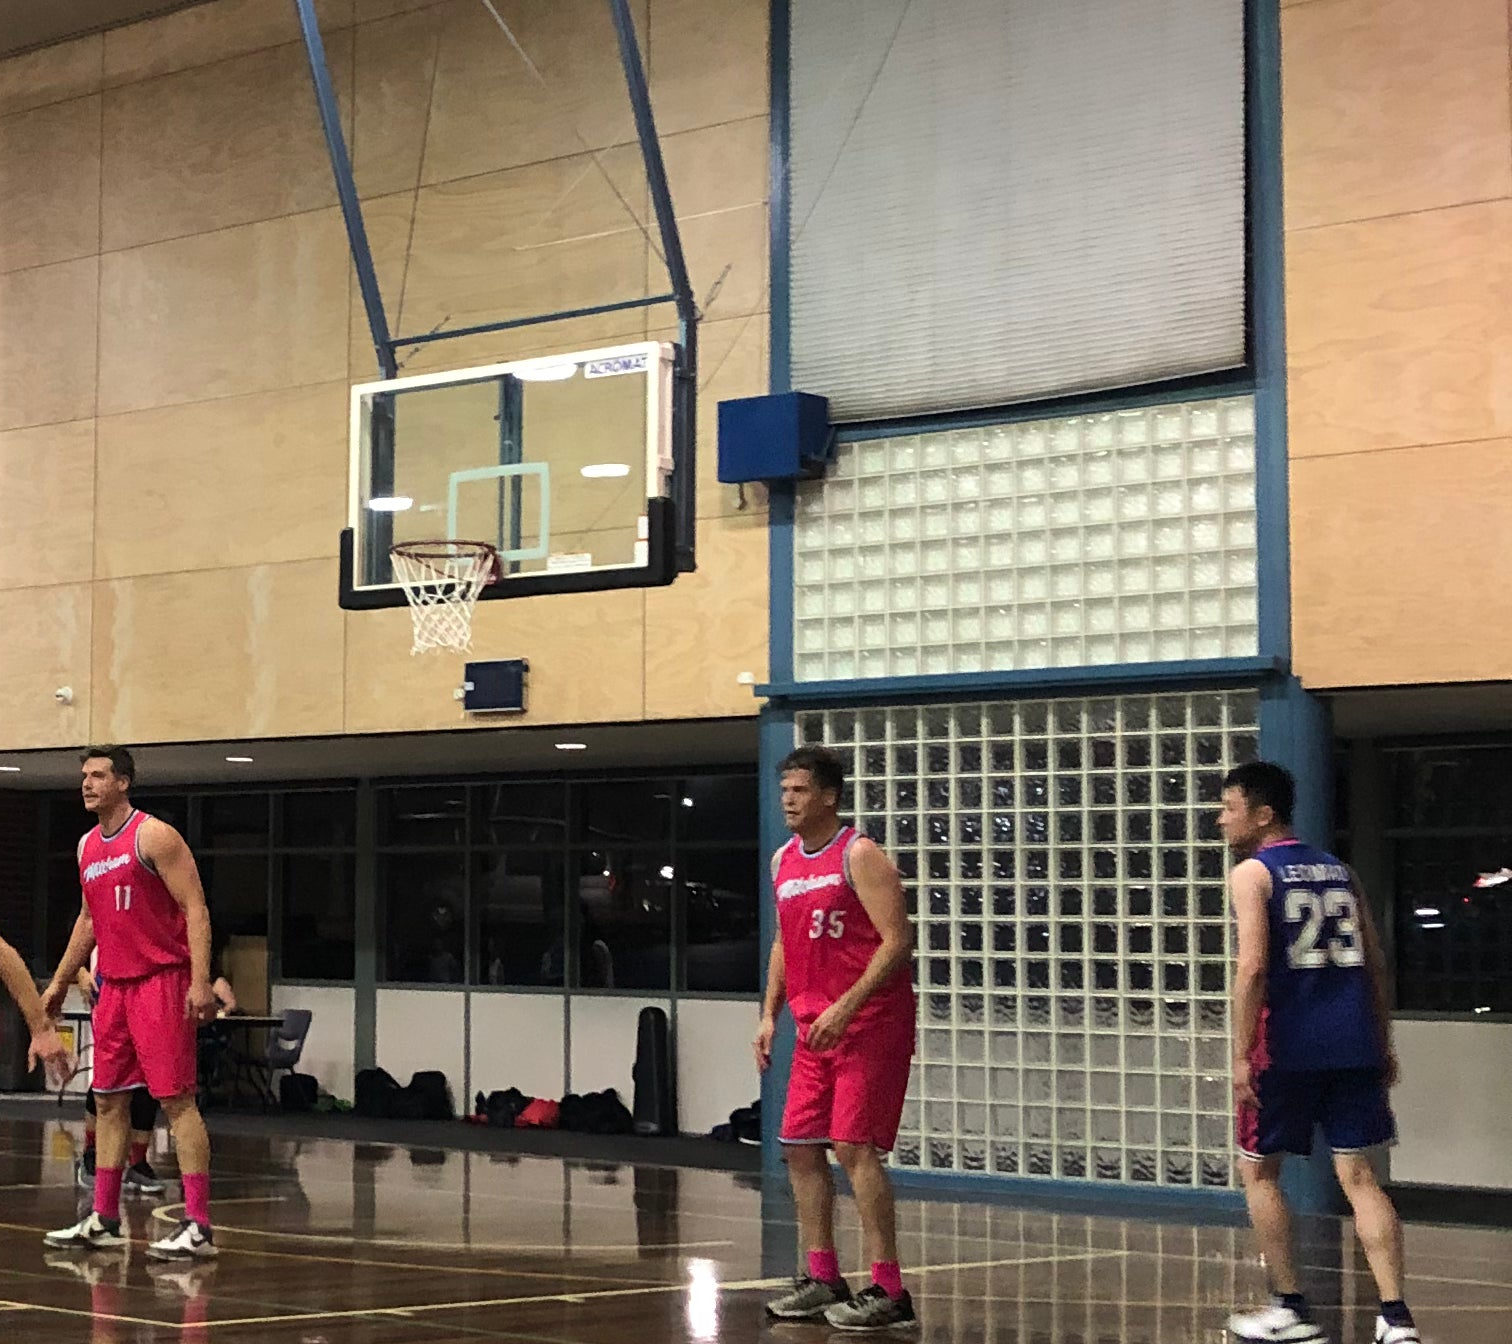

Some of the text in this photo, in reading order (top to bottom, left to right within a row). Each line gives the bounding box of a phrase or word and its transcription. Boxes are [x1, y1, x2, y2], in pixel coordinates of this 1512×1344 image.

[114, 884, 132, 912] 11
[808, 909, 847, 939] 35
[1282, 887, 1365, 969] 23
